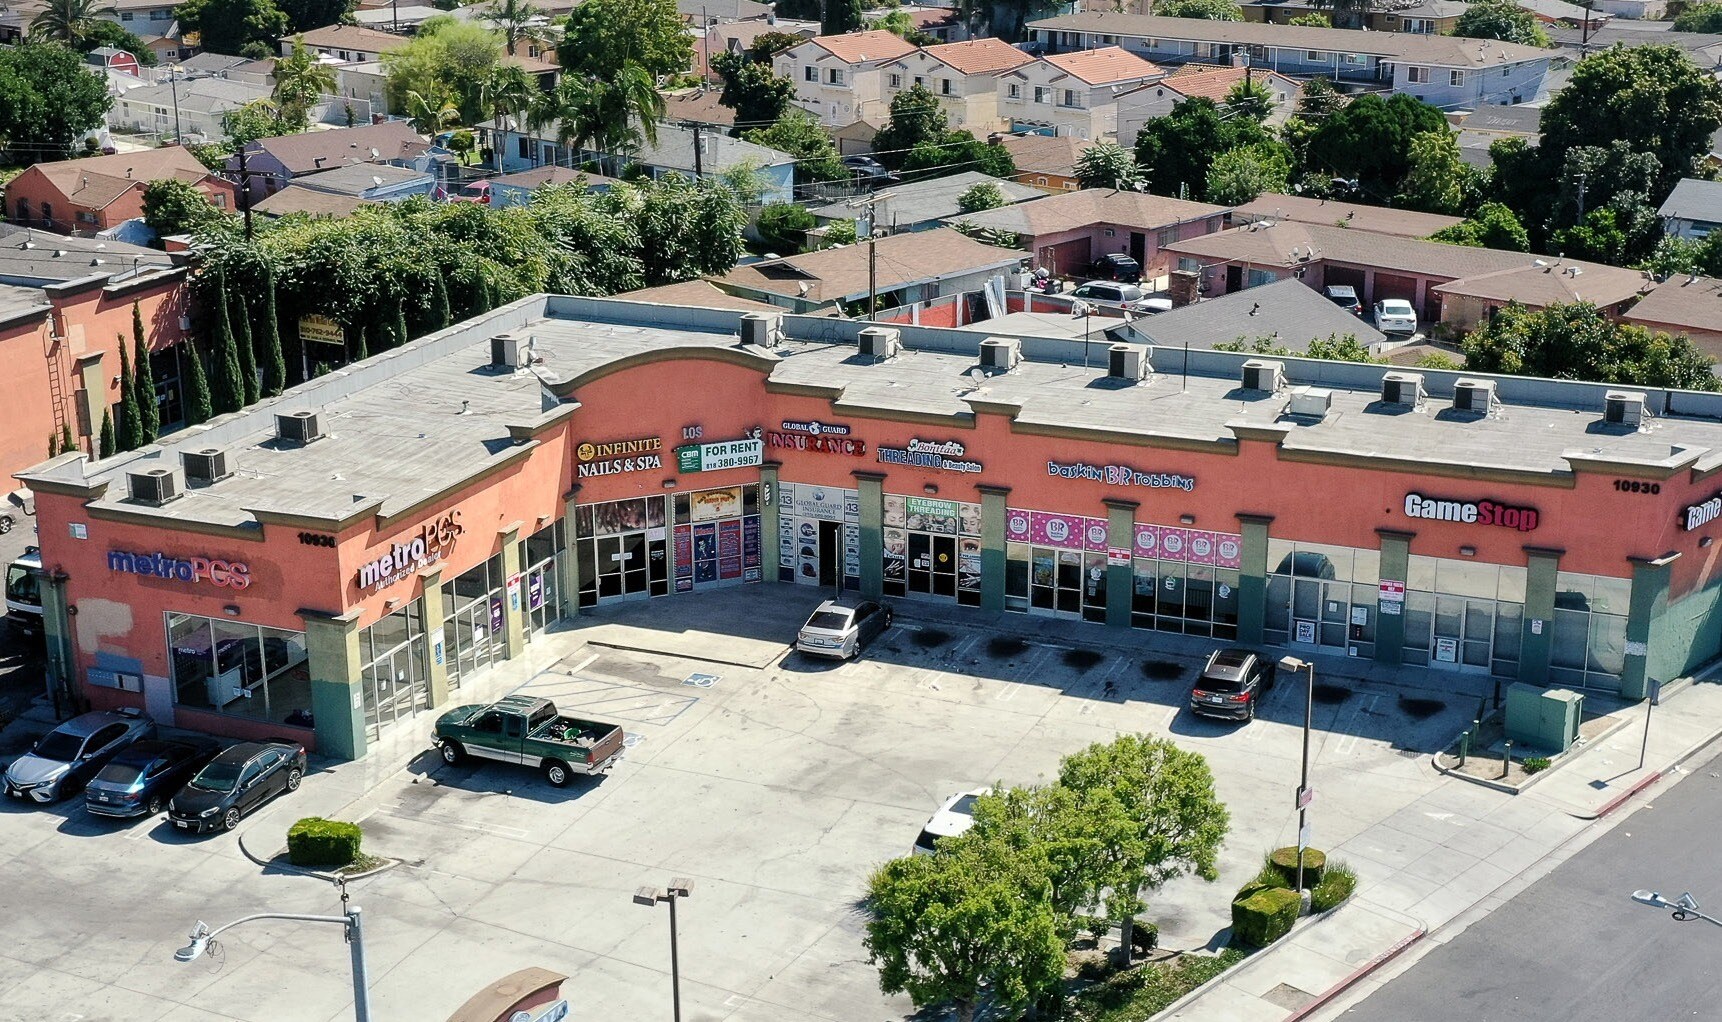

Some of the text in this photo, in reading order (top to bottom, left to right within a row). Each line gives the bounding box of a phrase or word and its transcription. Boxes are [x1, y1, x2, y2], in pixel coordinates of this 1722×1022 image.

[683, 427, 703, 440] LOS
[782, 422, 847, 434] GLOBAL GUARD
[596, 438, 662, 457] INFINITE
[705, 441, 759, 456] FOR RENT
[767, 432, 866, 457] INSURANCE
[578, 459, 622, 478] NAILS
[624, 458, 634, 472] &
[637, 455, 662, 471] SPA
[717, 455, 759, 468] 380-9967
[877, 448, 942, 469] THREADING
[948, 462, 966, 472] Beauty
[966, 463, 981, 472] Salon
[1047, 461, 1194, 492] baskin BR robbins
[1613, 479, 1661, 495] 10930
[796, 500, 842, 510] GLOBAL GUARD
[802, 506, 836, 515] INSURANCE
[909, 505, 956, 516] THREADING
[911, 498, 952, 509] EYEBROW
[1687, 491, 1722, 531] Game
[1404, 494, 1538, 531] GameStop
[297, 532, 337, 548] 10930
[107, 551, 251, 590] metroPCS
[375, 551, 441, 592] Authorized Dealer
